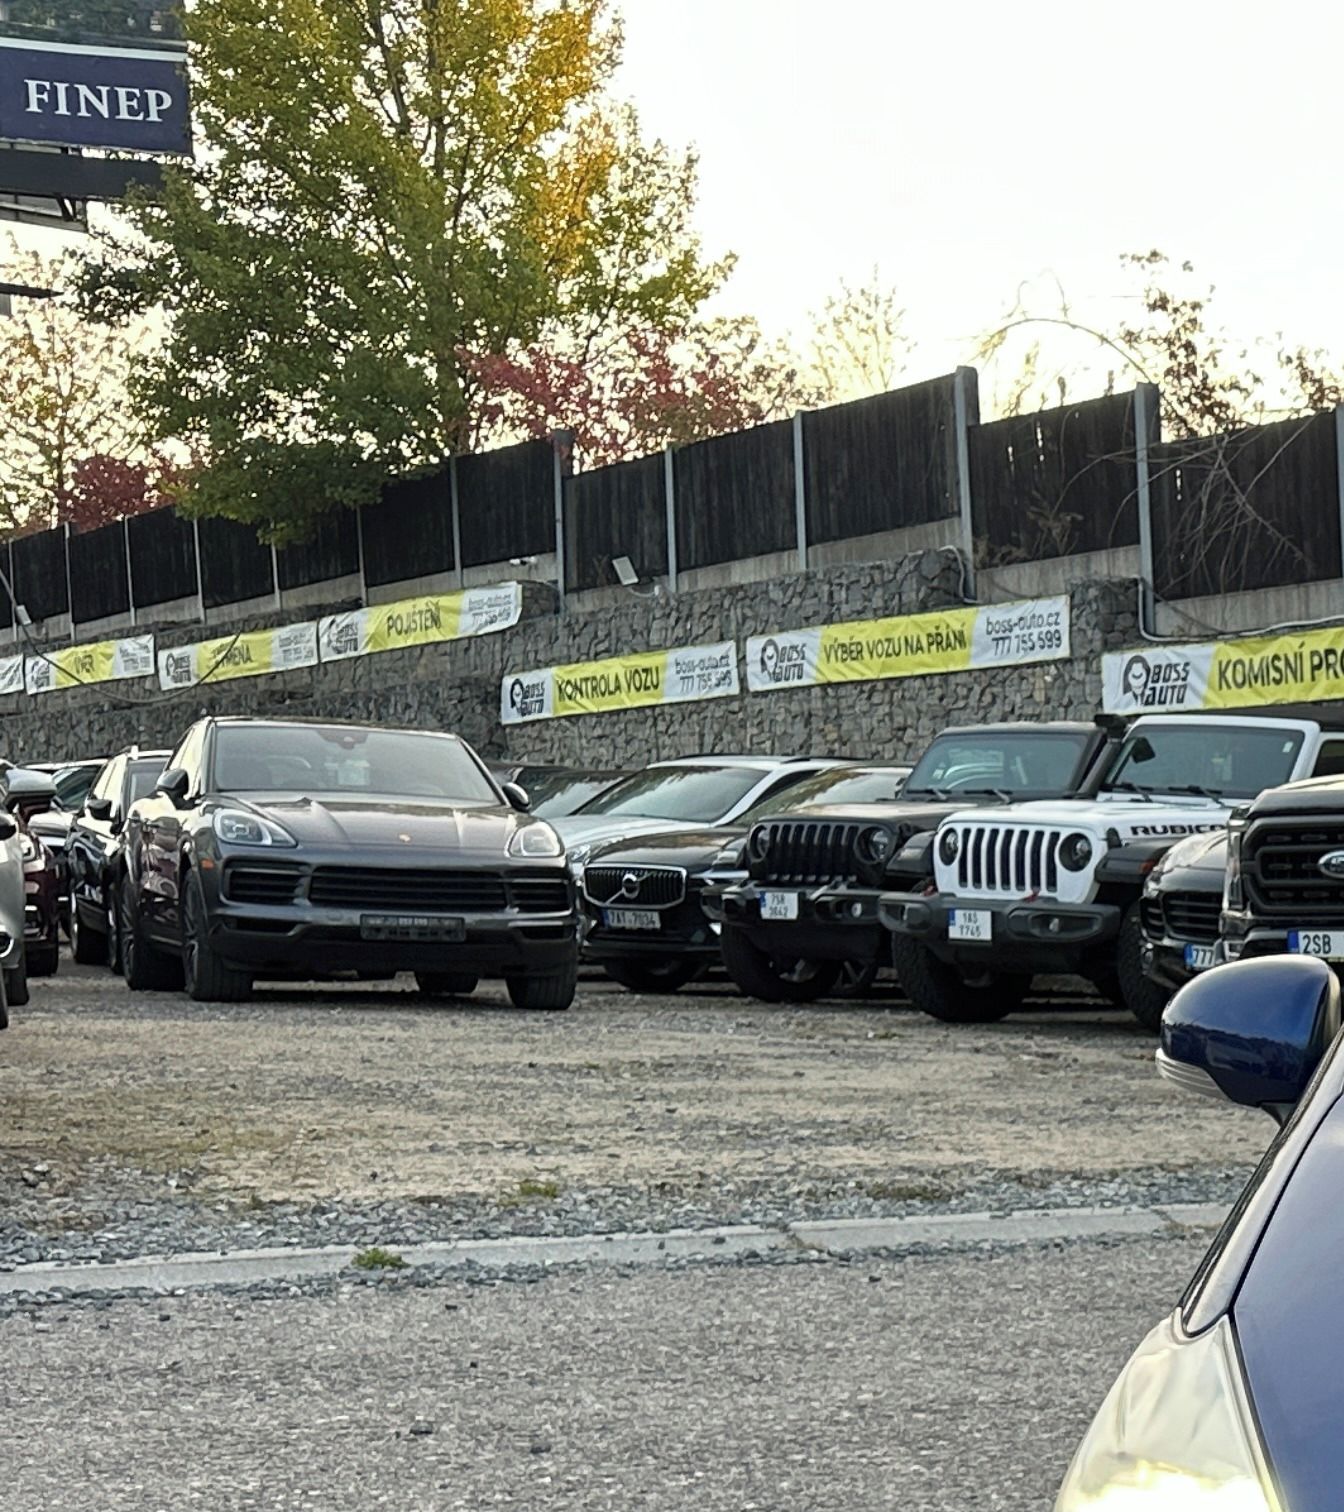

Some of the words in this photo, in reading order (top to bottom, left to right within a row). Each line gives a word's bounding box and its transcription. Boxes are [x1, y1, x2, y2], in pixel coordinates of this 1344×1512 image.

[24, 79, 173, 122] FINEP
[866, 633, 901, 659] VOZU
[904, 634, 924, 656] NA
[991, 636, 1012, 656] 777
[1037, 628, 1063, 651] 599
[1151, 661, 1191, 684] BOSS
[1217, 641, 1305, 691] KOMISNÍ
[557, 674, 621, 703] KONTROLA
[624, 666, 660, 694] VOZU
[1144, 683, 1188, 707] AUTO
[1302, 934, 1332, 954] 2SB
